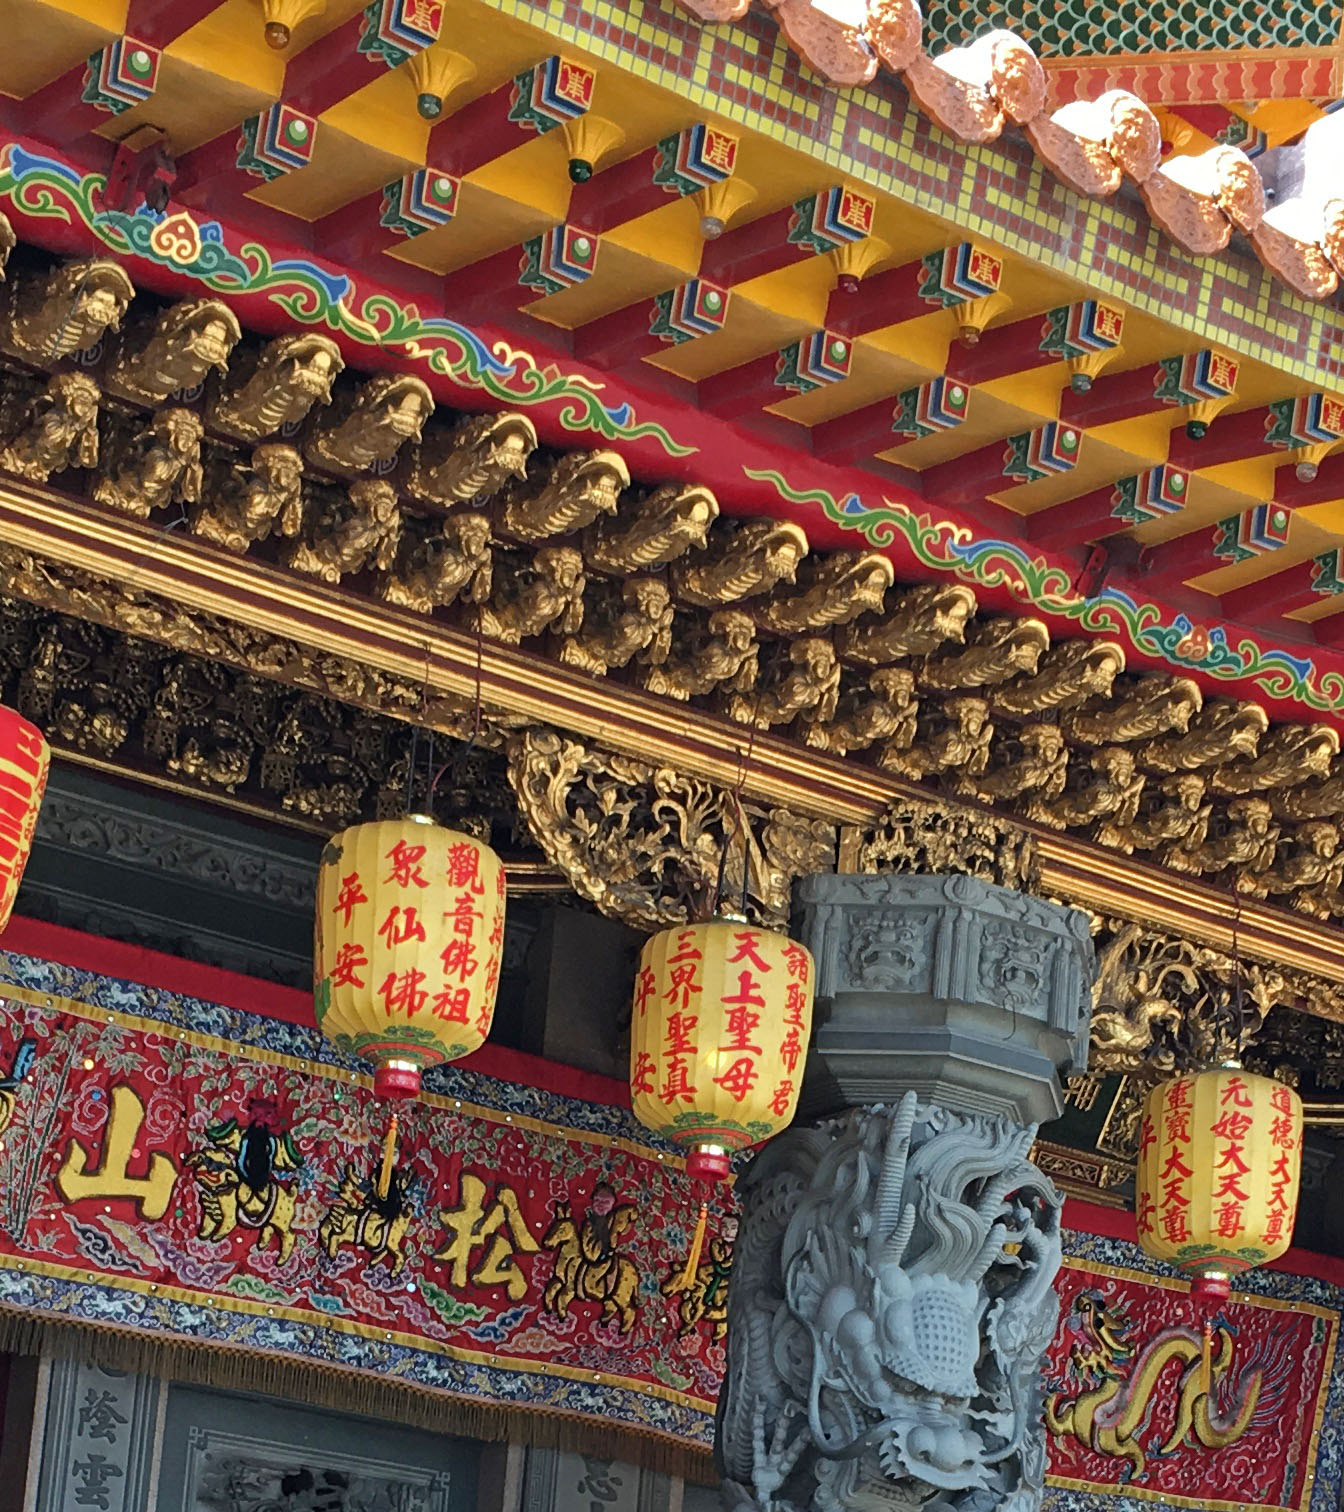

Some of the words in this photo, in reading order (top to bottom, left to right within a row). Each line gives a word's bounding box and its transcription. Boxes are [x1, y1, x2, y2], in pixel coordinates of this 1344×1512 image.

[330, 872, 368, 989] 平安
[432, 842, 484, 1025] 觀音佛祖
[631, 965, 656, 1096] 平安
[658, 931, 703, 1105] 三界聖真
[713, 932, 772, 1103] 天上聖母
[768, 942, 809, 1117] 諸聖帝君
[1158, 1078, 1195, 1243] 靈寶大天尊
[1210, 1077, 1253, 1239] 元始大天尊
[1260, 1086, 1296, 1246] 道德大天尊
